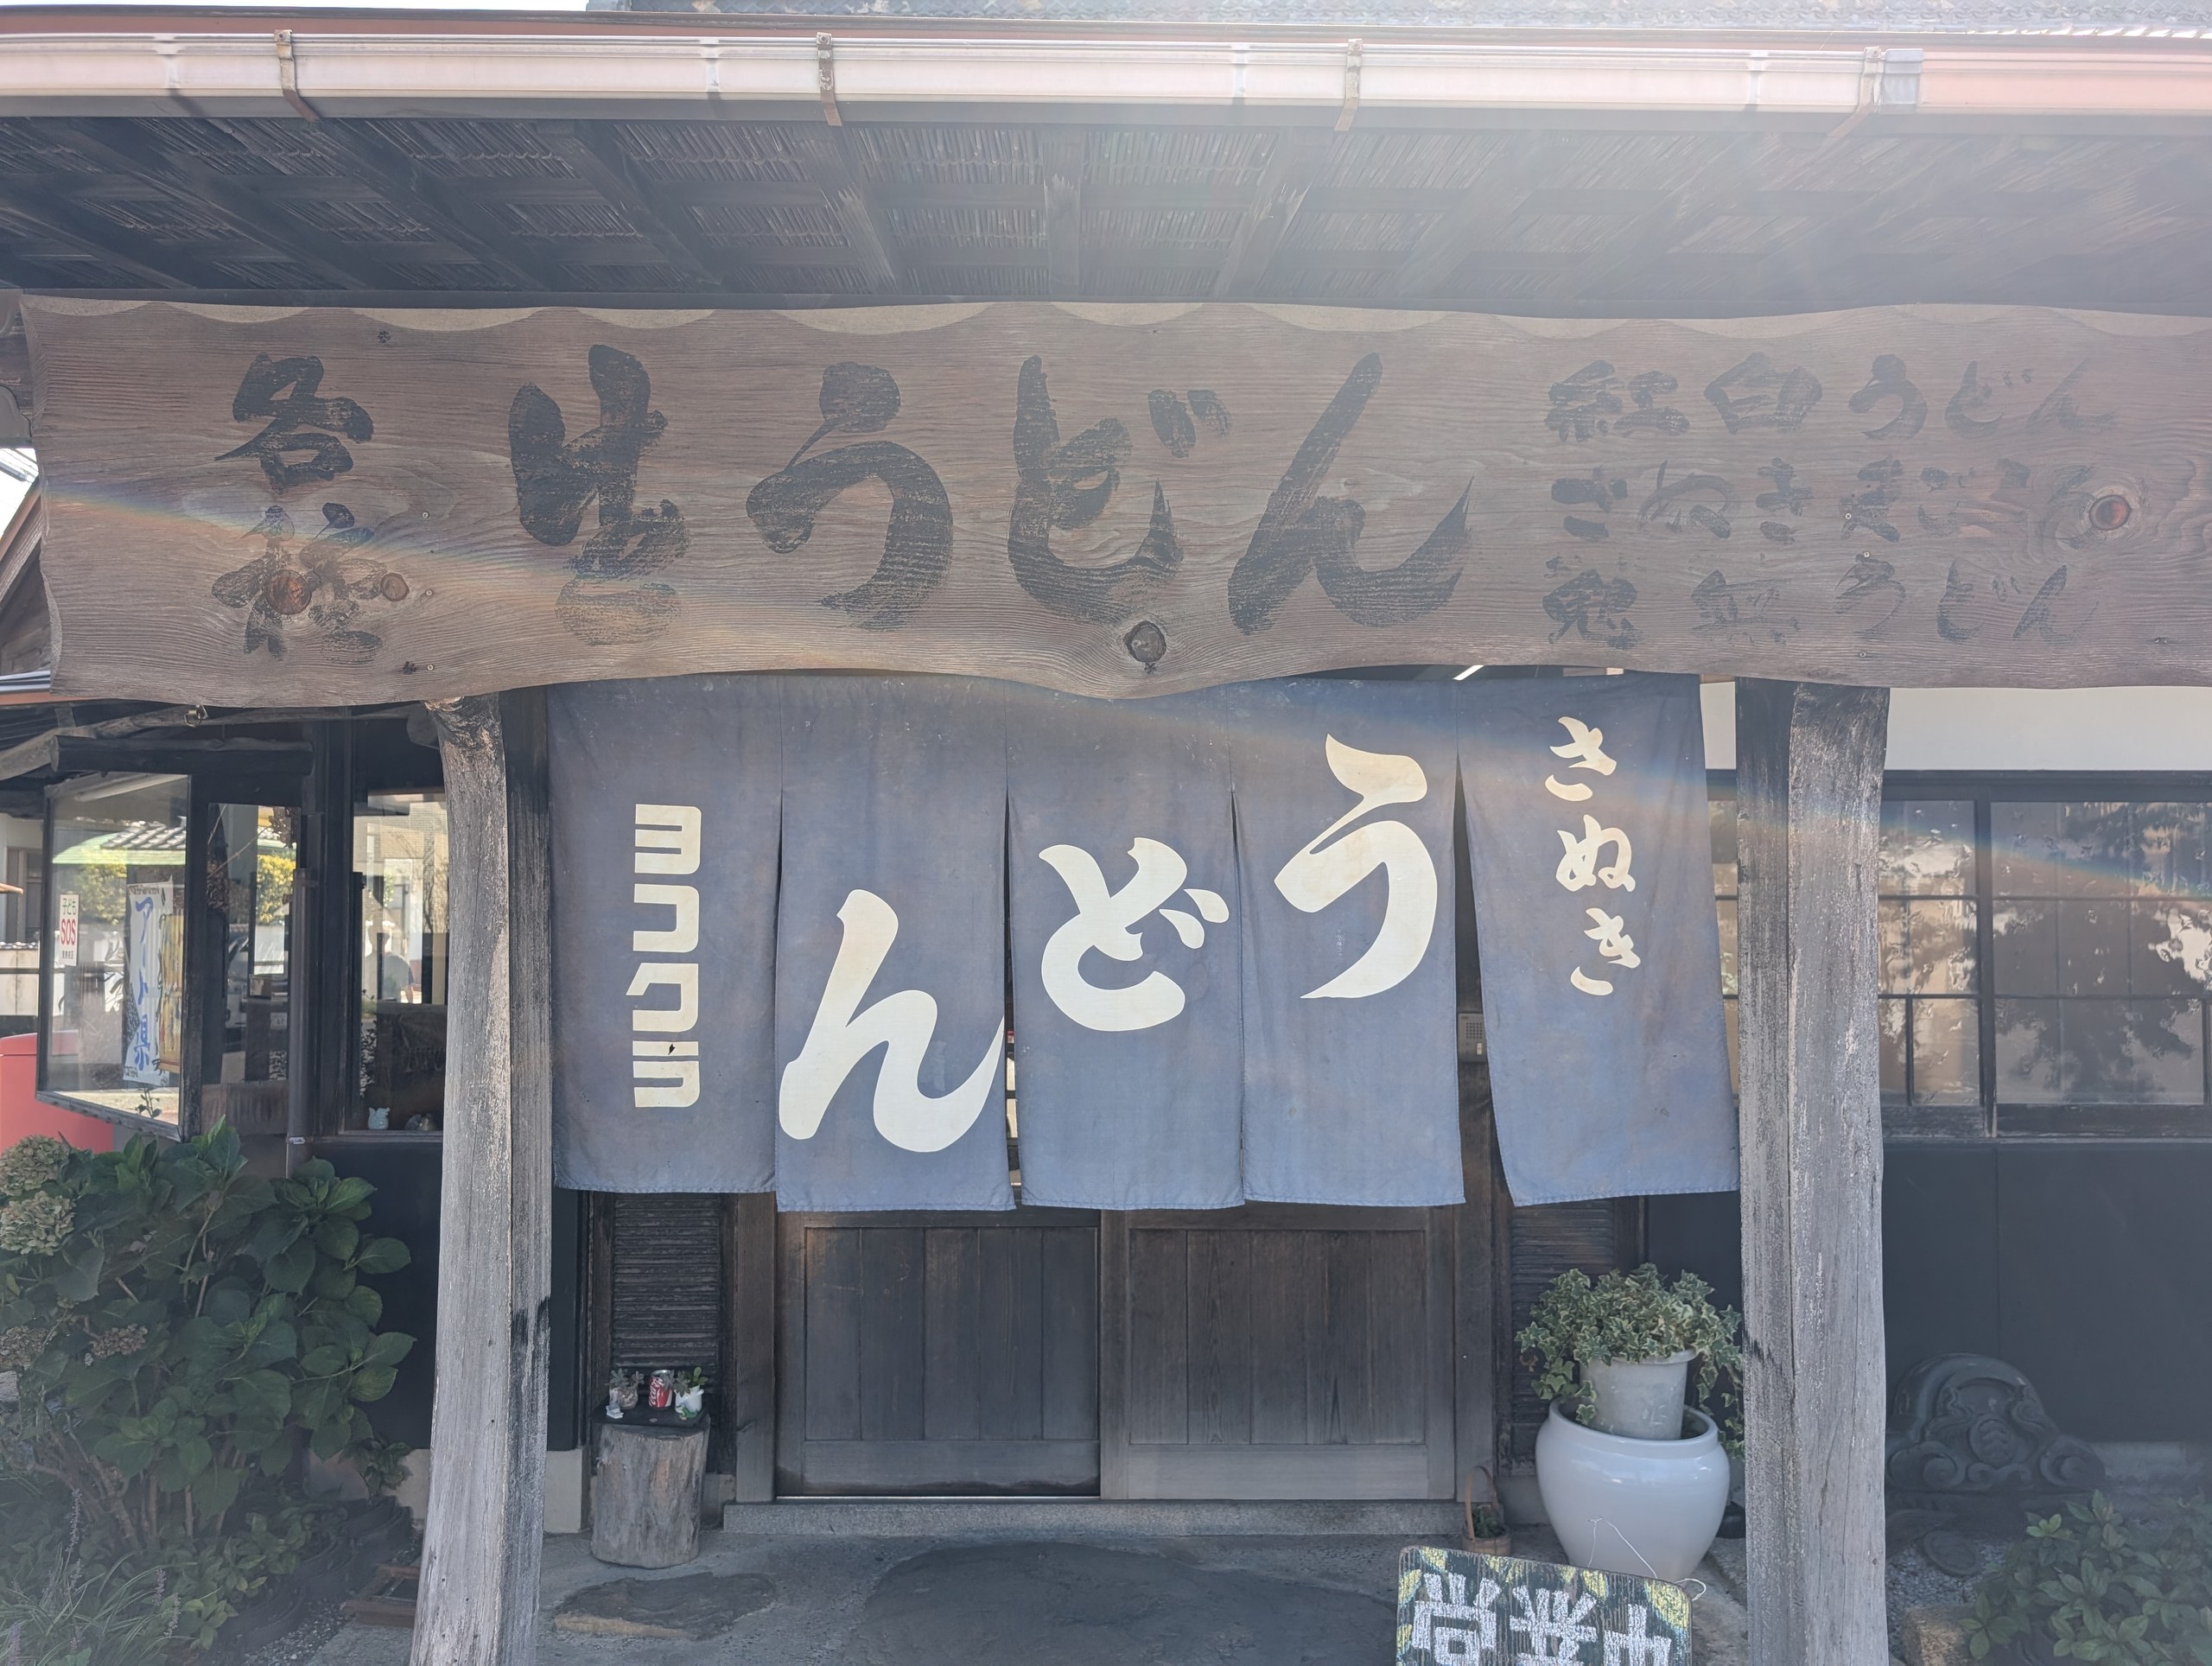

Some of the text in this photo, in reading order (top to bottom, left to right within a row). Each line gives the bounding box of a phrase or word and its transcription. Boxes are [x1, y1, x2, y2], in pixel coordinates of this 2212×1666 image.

[60, 919, 76, 945] SOS
[62, 898, 76, 915] 子ども
[1545, 716, 1641, 996] さぬき
[779, 733, 1437, 1154] うどん
